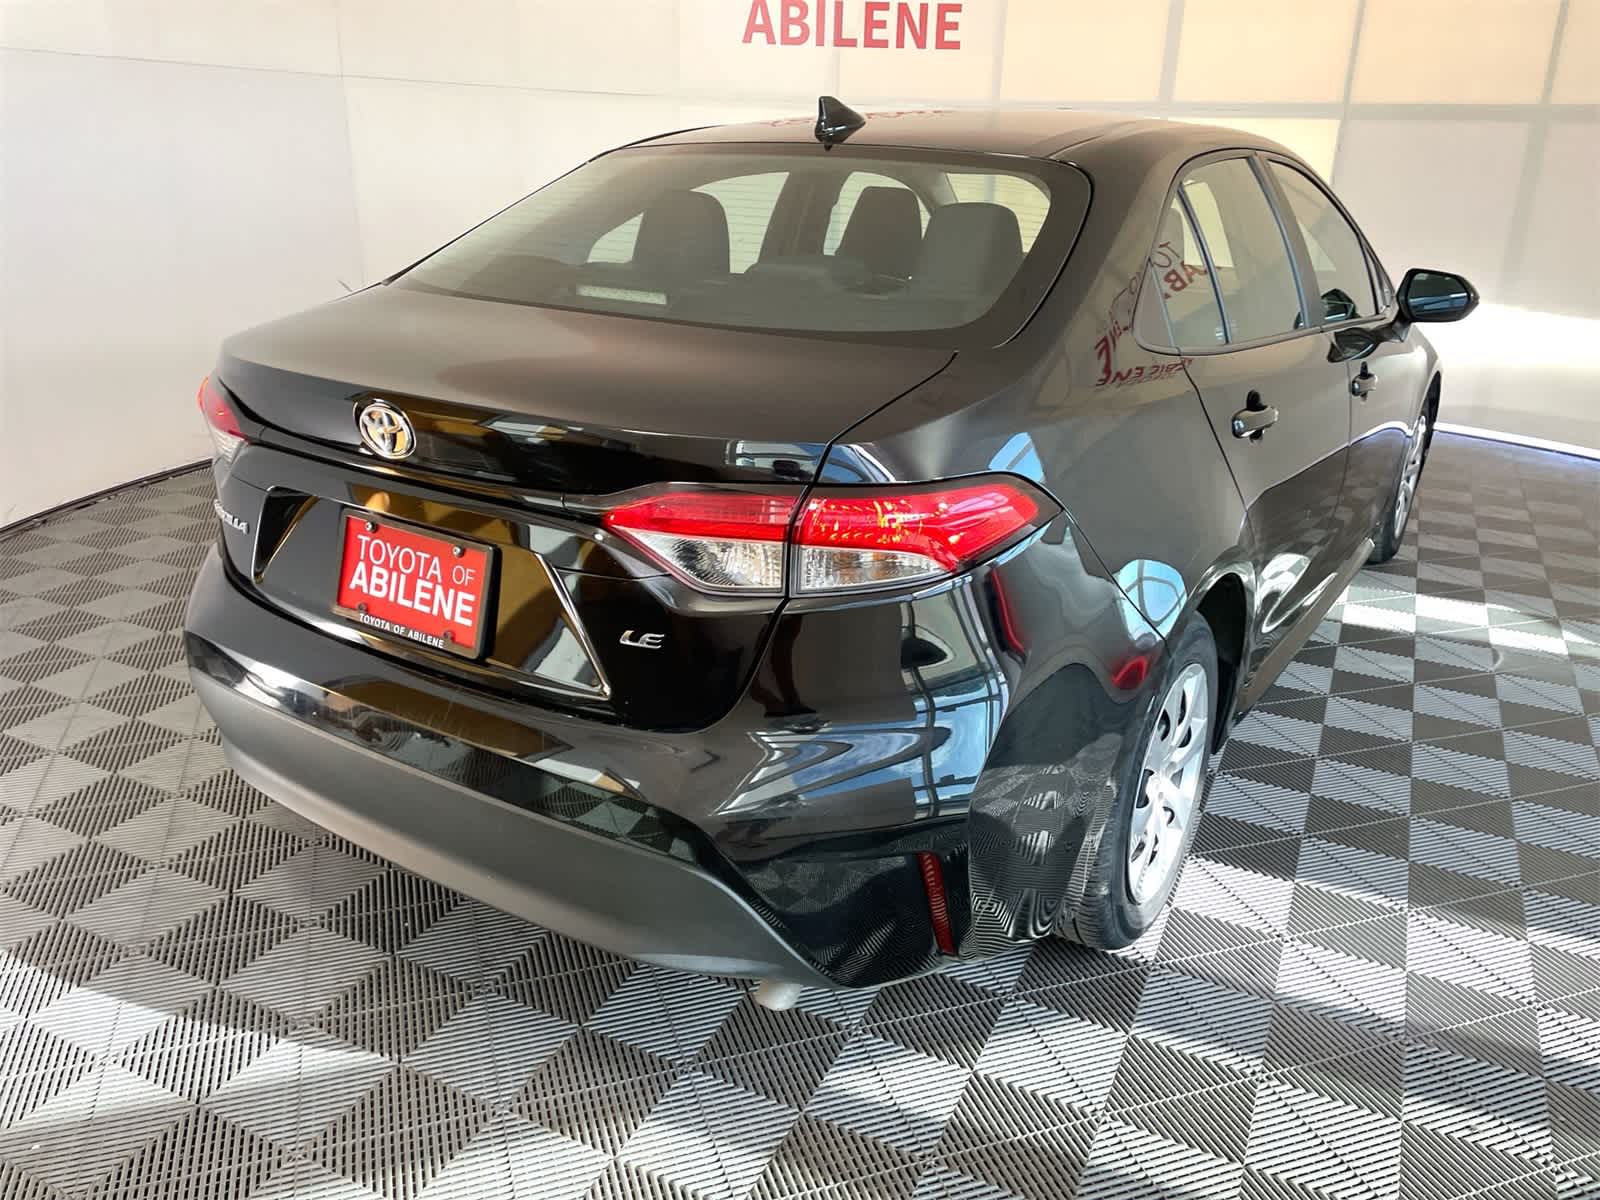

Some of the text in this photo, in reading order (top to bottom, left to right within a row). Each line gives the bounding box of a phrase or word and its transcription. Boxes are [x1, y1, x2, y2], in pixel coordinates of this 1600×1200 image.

[742, 0, 962, 50] ABILENE
[357, 534, 476, 586] TOYOTA OF
[349, 561, 475, 627] ABILENE
[359, 613, 445, 649] TOYOTA OF ABILENE
[619, 629, 665, 649] LE
